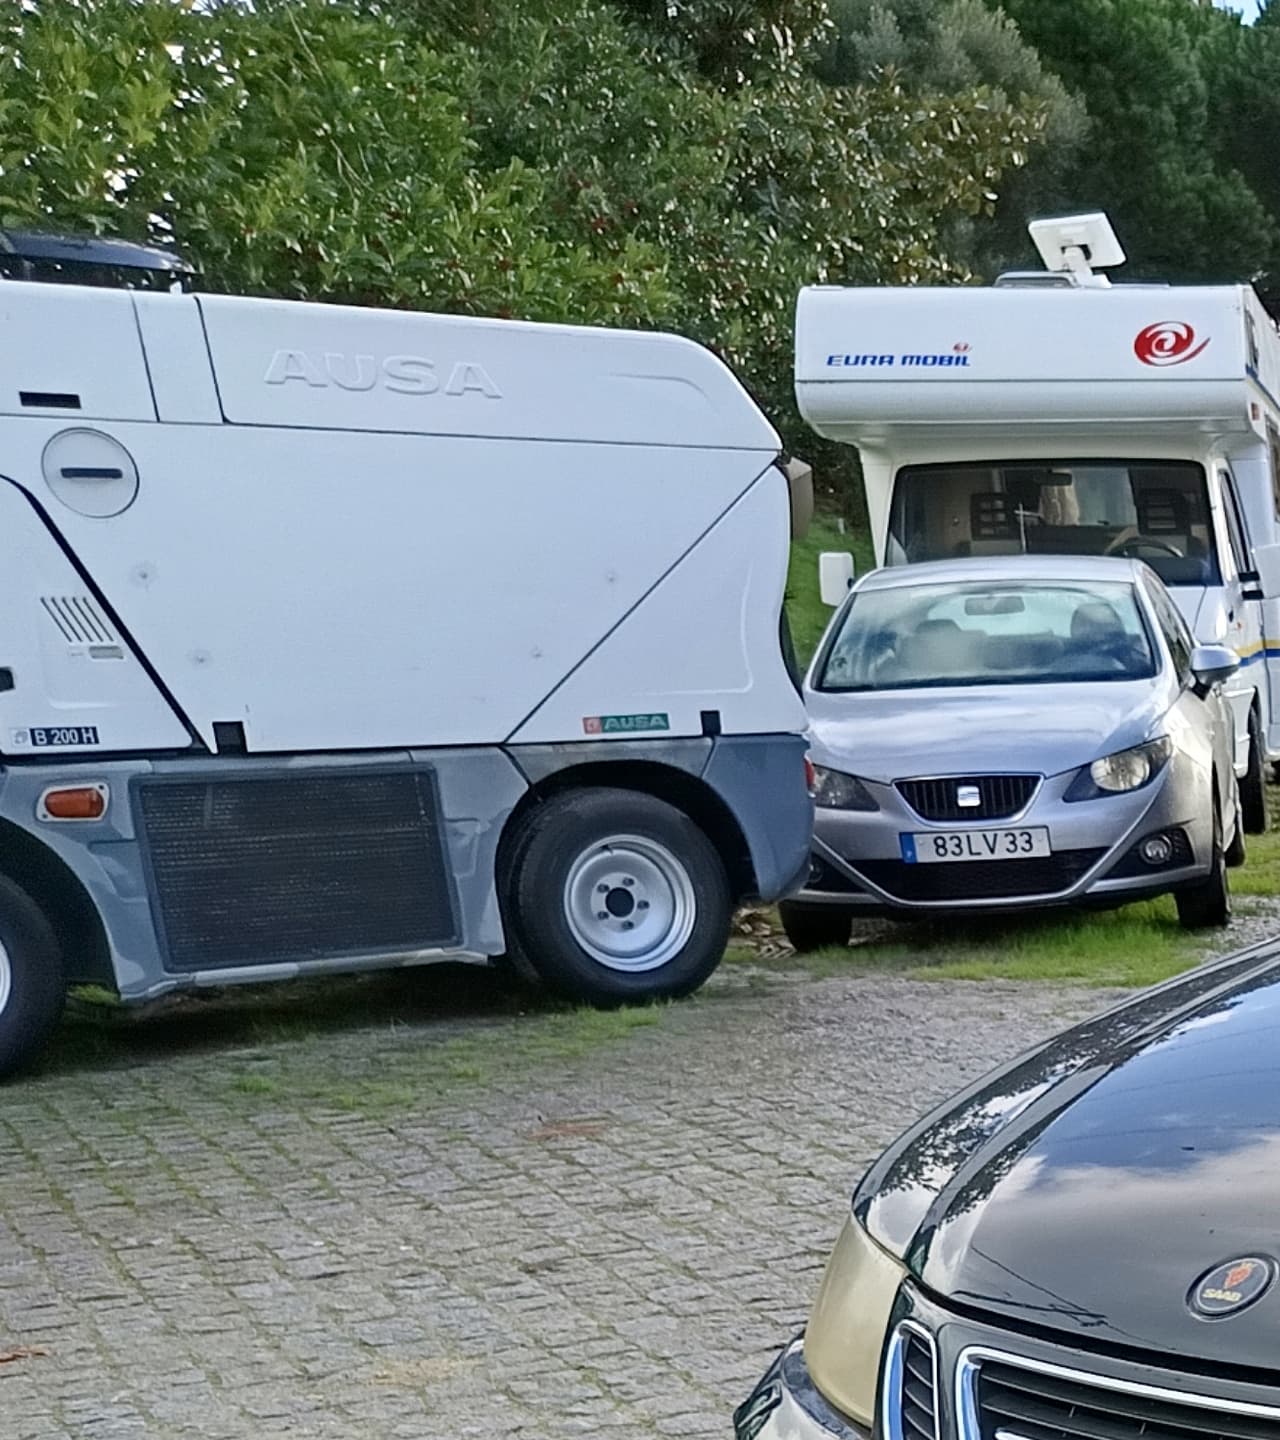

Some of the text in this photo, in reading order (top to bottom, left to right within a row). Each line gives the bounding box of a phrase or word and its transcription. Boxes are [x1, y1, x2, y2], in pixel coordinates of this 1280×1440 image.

[826, 354, 971, 367] EURA MOBIL
[264, 350, 503, 400] AUSA
[604, 715, 667, 731] AUSA
[34, 727, 96, 746] B 200 H
[1202, 1288, 1242, 1302] SAAB
